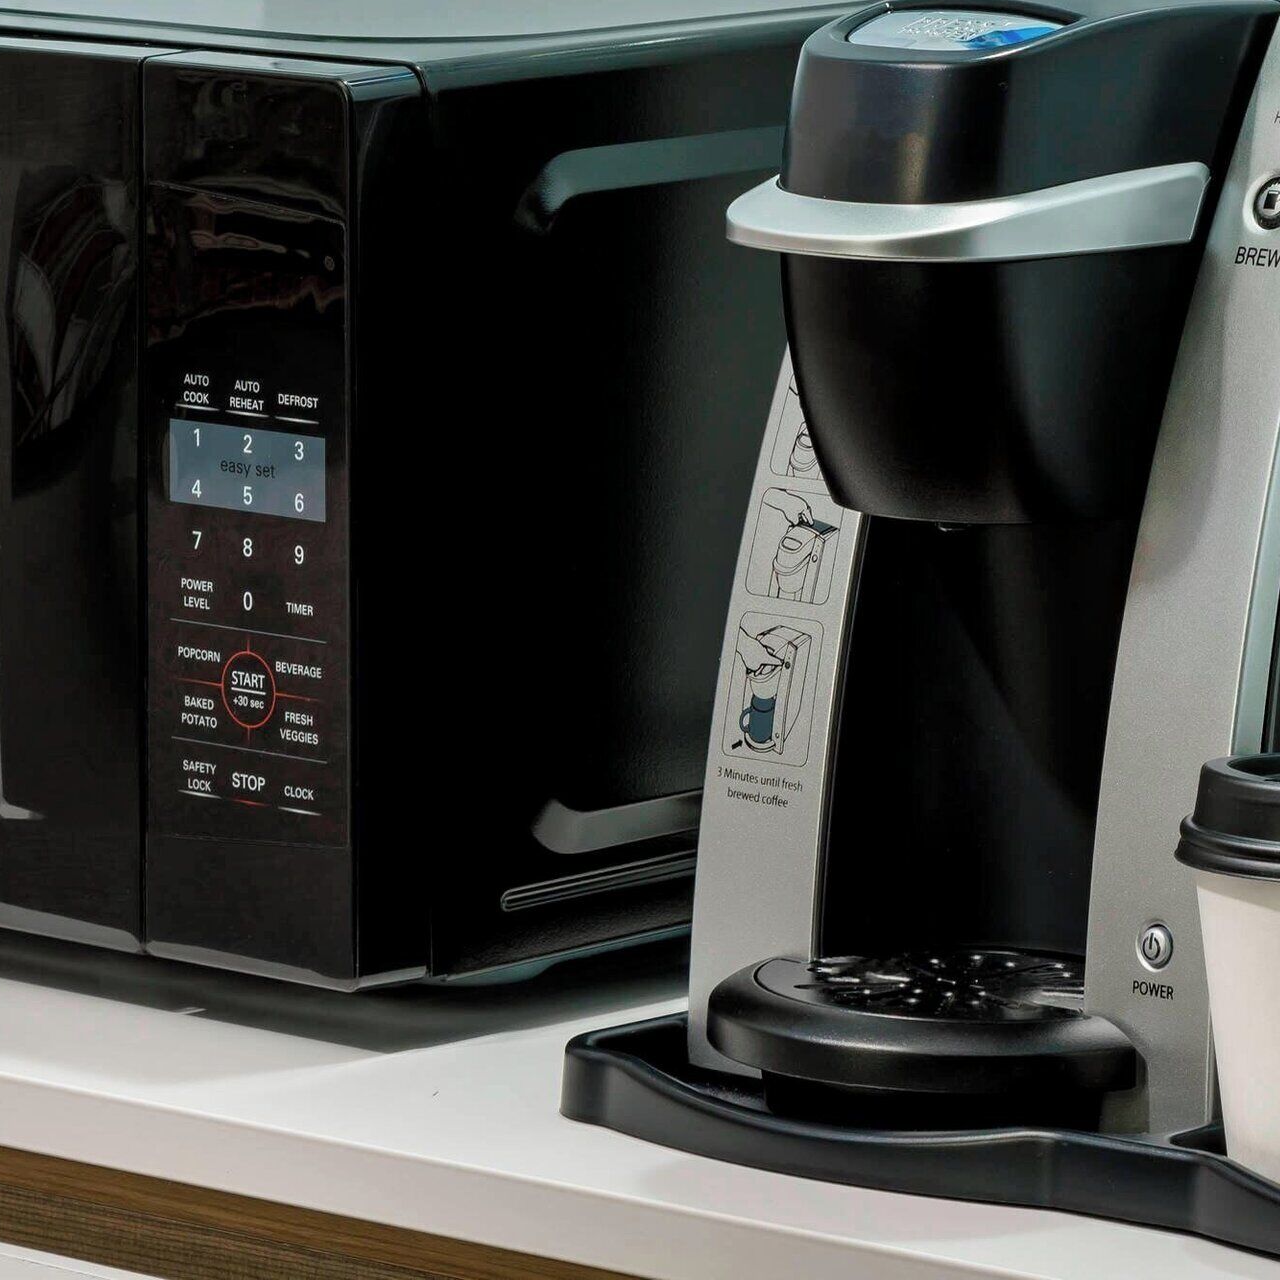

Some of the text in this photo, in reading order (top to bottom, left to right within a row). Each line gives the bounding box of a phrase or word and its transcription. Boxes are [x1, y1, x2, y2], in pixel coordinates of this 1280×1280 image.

[184, 374, 209, 387] AUTO
[234, 380, 260, 393] AUTO
[183, 391, 209, 404] COOK
[230, 396, 264, 411] REHEAT
[278, 393, 318, 409] DEFROST
[193, 428, 200, 447] 1
[243, 434, 253, 454] 2
[294, 441, 304, 460] 3
[220, 459, 276, 479] easy set
[191, 479, 202, 498] 4
[243, 486, 253, 505] 5
[294, 493, 304, 513] 6
[192, 531, 202, 550] 7
[242, 538, 253, 557] 8
[294, 545, 304, 565] 9
[181, 577, 213, 592] POWER
[183, 596, 210, 610] LEVEL
[243, 591, 253, 611] 0
[286, 601, 314, 616] TIMER
[178, 645, 220, 663] POPCORN
[275, 661, 322, 679] BEVERAGE
[231, 671, 265, 689] START
[184, 696, 214, 710] BAKED
[233, 695, 264, 709] +30 sec
[181, 713, 217, 728] POTATO
[284, 711, 313, 726] FRESH
[280, 728, 319, 745] VEGGIES
[183, 759, 216, 774] SAFETY
[187, 778, 211, 792] LOCK
[232, 772, 266, 791] STOP
[717, 766, 803, 792] 3 Minutes until fresh
[284, 785, 314, 800] CLOCK
[727, 787, 789, 808] brewed coffee
[1132, 980, 1174, 1000] POWER
